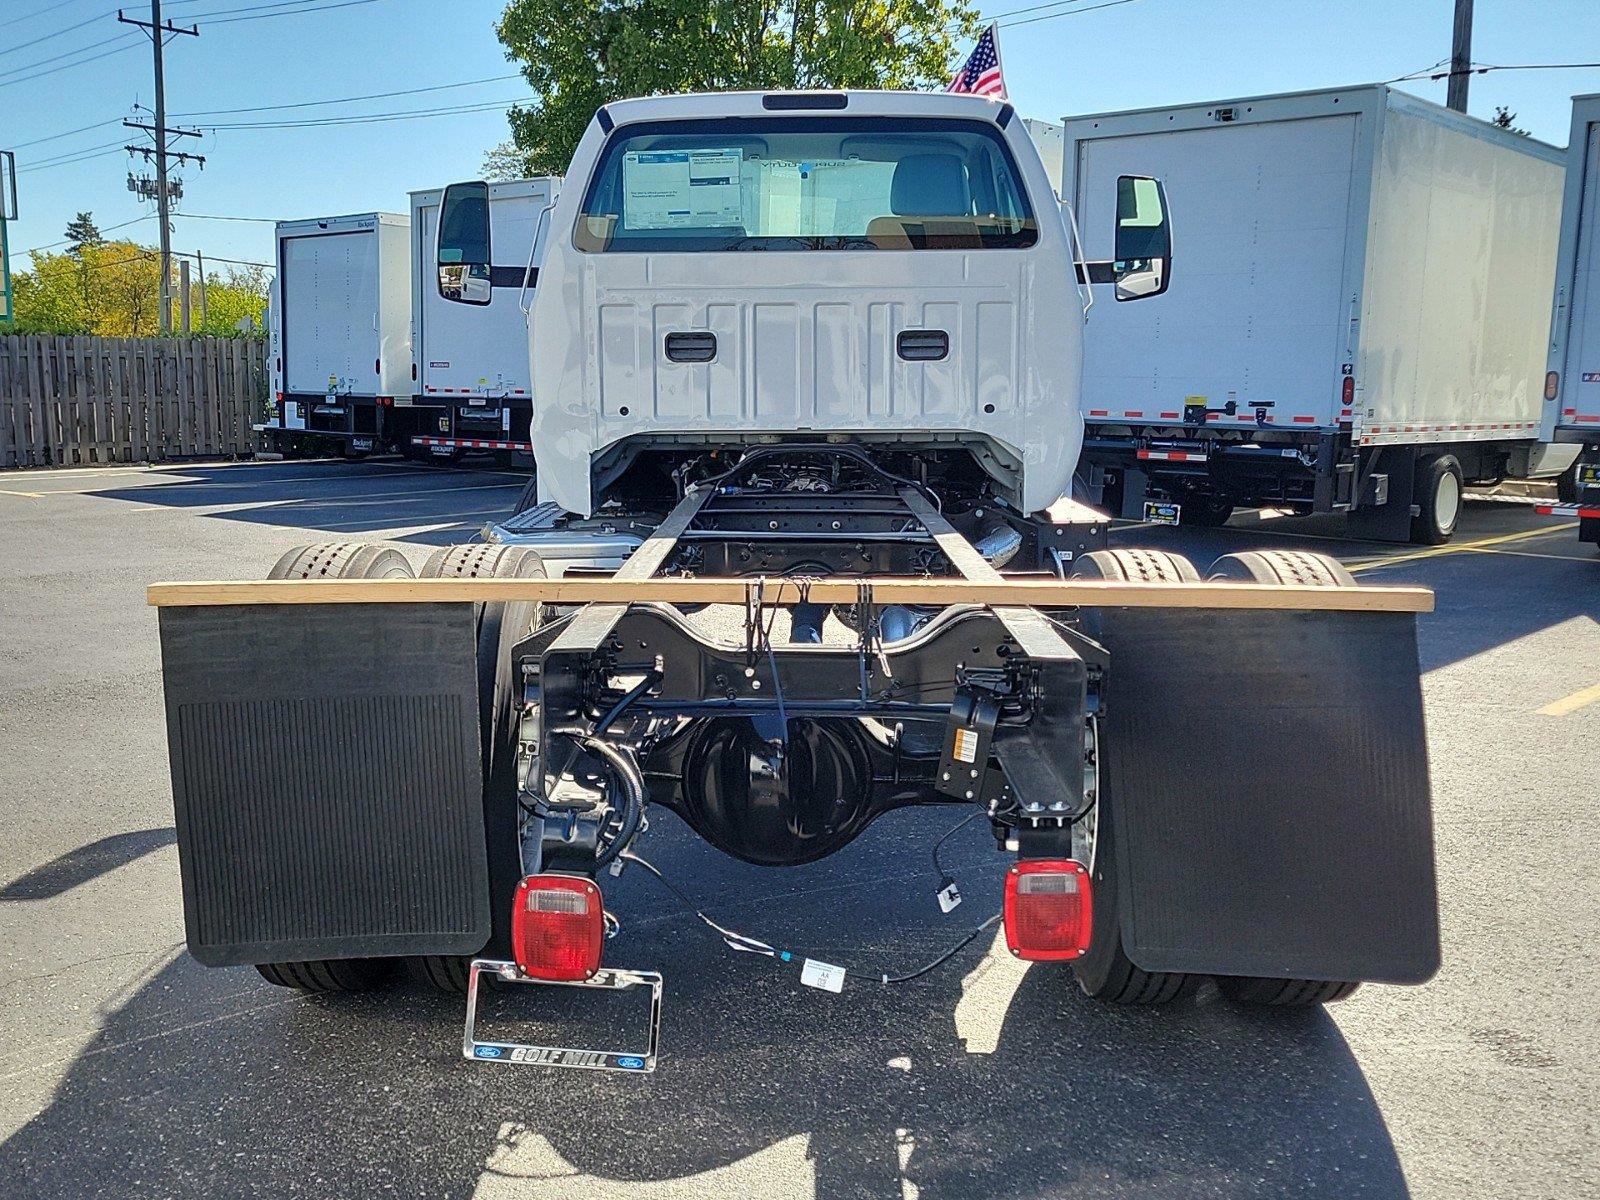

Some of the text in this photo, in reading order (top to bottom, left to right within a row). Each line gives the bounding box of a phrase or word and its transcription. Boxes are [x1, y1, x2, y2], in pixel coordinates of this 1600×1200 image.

[477, 1046, 499, 1058] Ford
[510, 1048, 607, 1067] GOLF MILL
[619, 1057, 642, 1068] Ford
